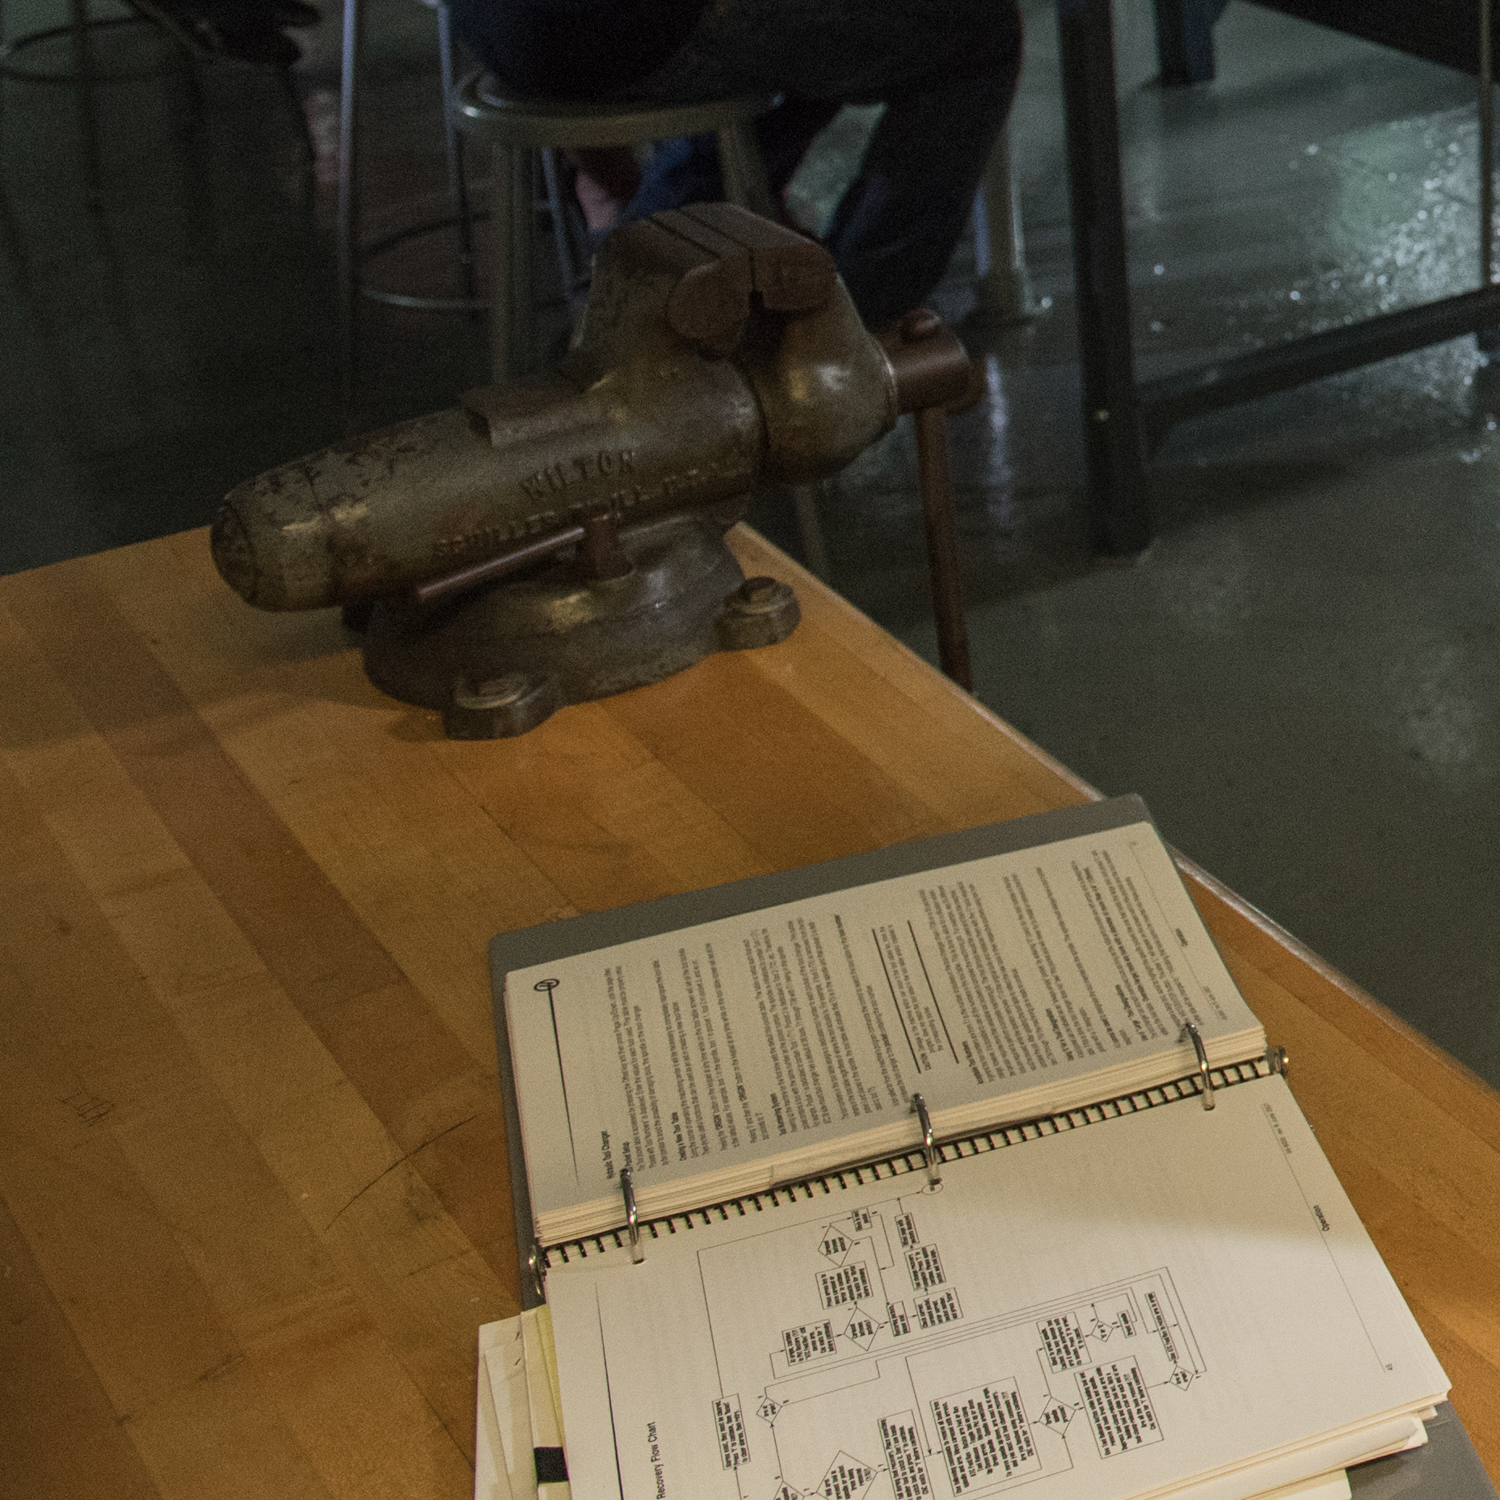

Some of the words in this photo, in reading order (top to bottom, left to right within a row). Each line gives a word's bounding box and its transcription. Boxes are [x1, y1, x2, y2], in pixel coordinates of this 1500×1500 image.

[521, 449, 636, 498] WILTON
[1313, 1204, 1330, 1232] Operation
[646, 1421, 658, 1442] Chart
[650, 1443, 661, 1463] Flow
[653, 1463, 667, 1500] Recovery
